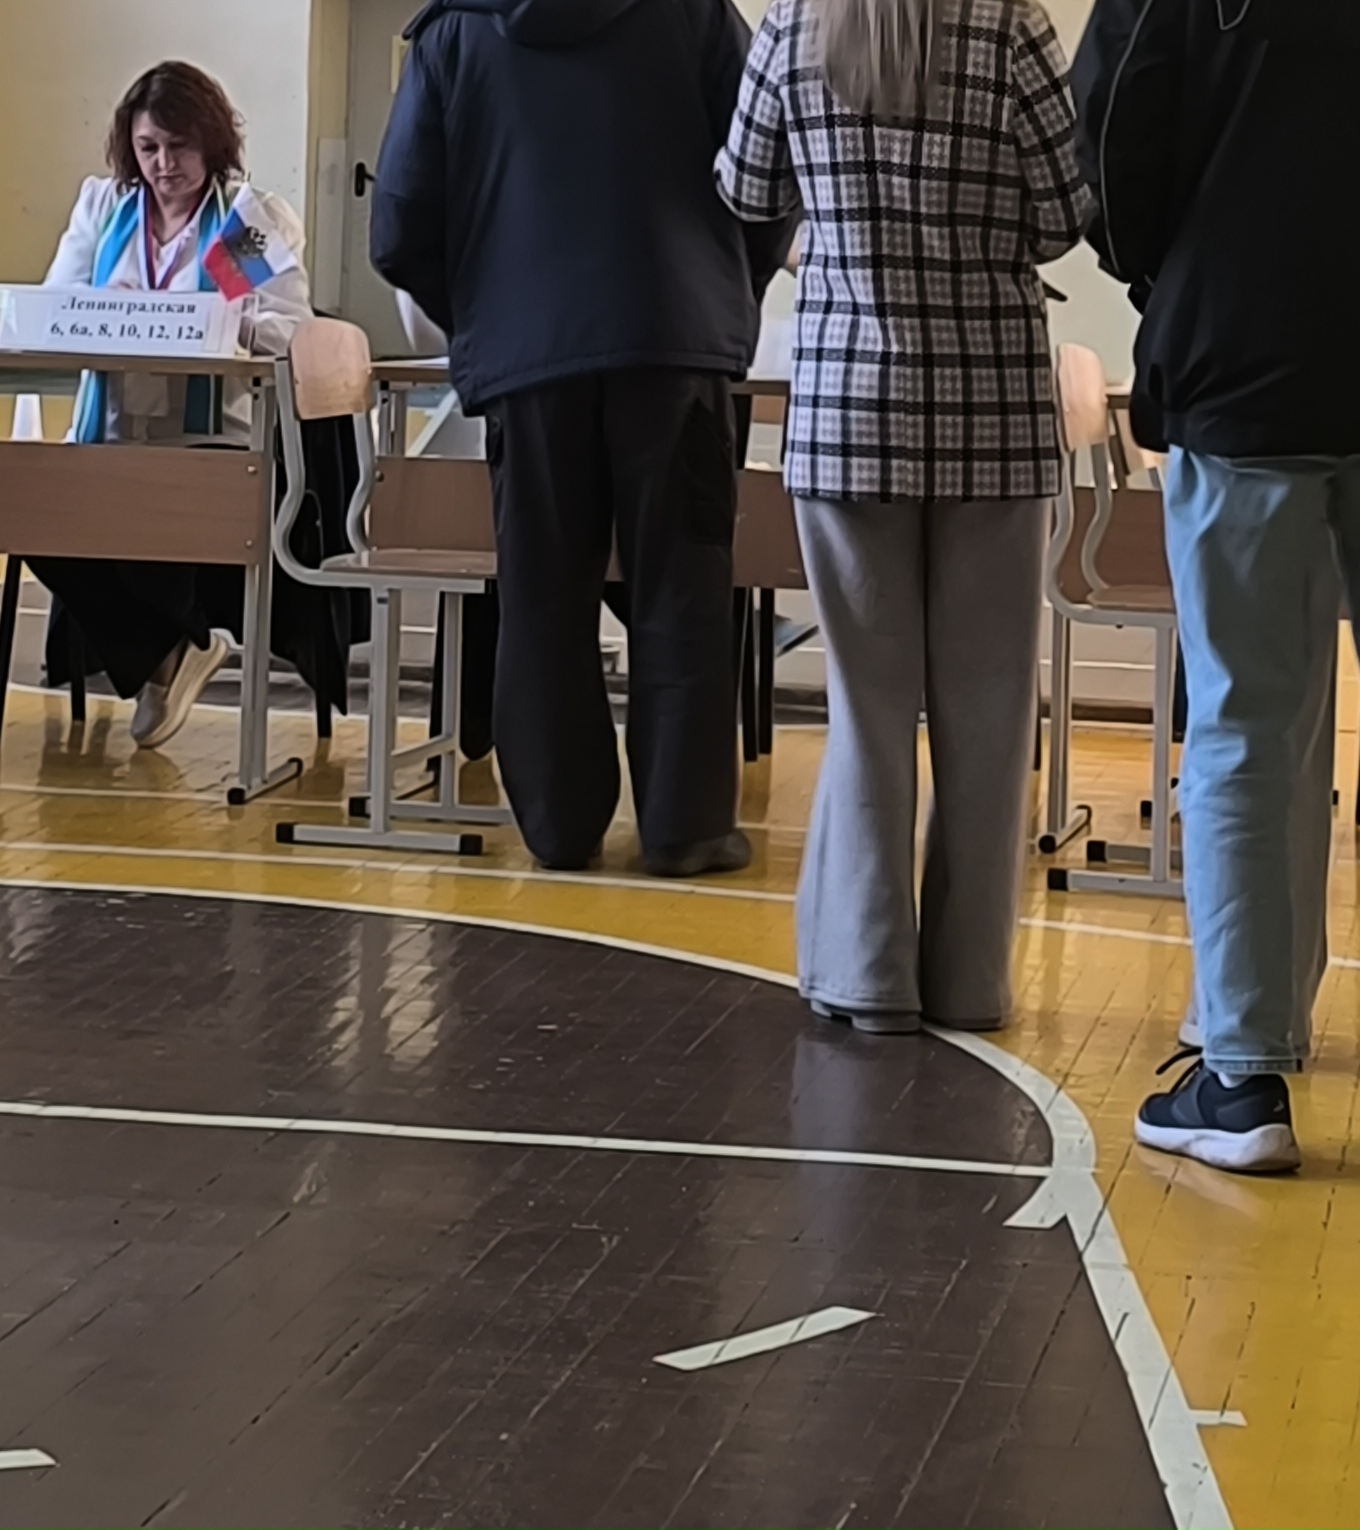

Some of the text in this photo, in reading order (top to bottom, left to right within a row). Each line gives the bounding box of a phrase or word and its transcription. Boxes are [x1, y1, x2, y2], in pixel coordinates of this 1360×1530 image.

[61, 296, 197, 315] Ленинградская
[50, 321, 204, 341] 6, 6а, 8, 10, 12, 12а
